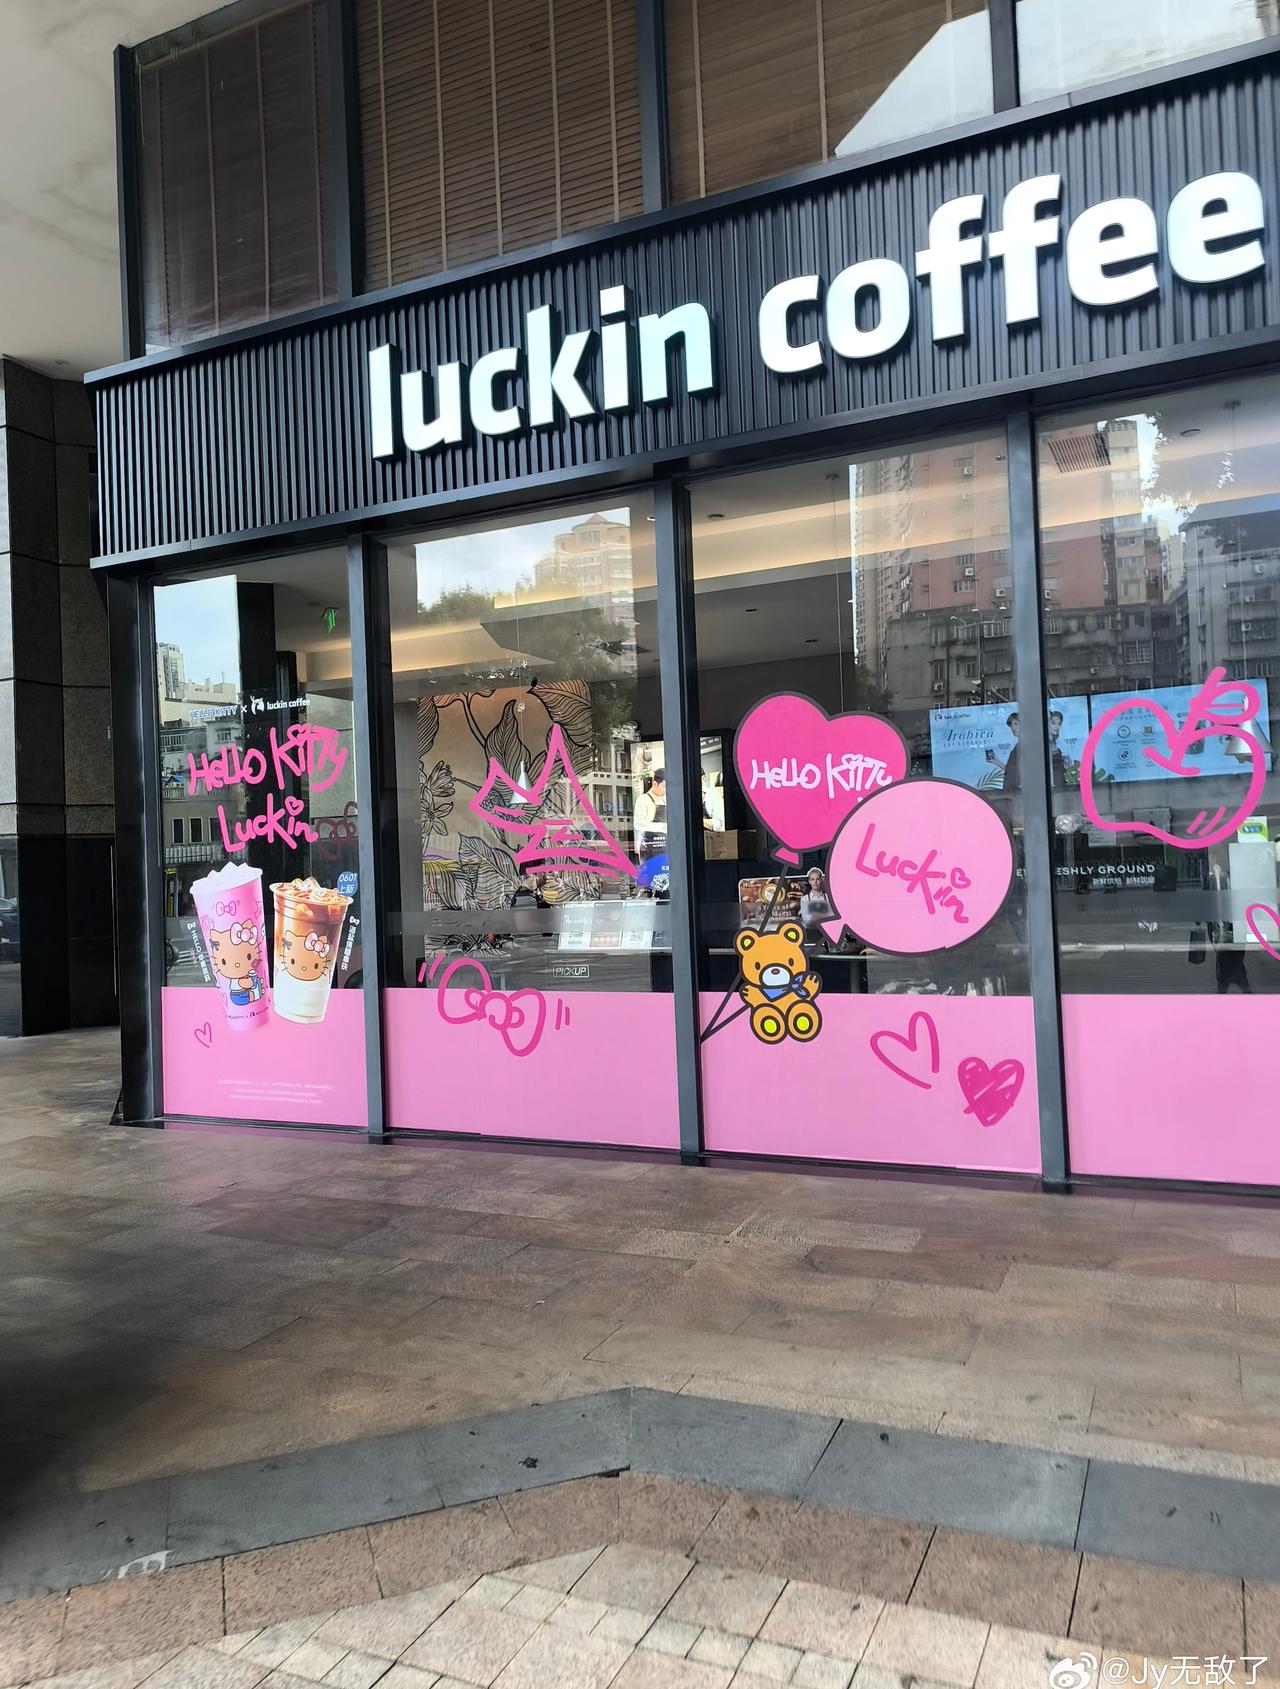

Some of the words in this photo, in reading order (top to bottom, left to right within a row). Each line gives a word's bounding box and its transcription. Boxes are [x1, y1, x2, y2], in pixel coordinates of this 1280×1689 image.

[368, 284, 715, 460] luckin
[757, 171, 1266, 375] coffee
[214, 705, 238, 717] KITTY
[266, 700, 287, 710] luckin
[289, 697, 311, 707] coffee
[1097, 864, 1156, 875] GROUND
[339, 872, 357, 882] 0601
[555, 966, 587, 976] PICKUP
